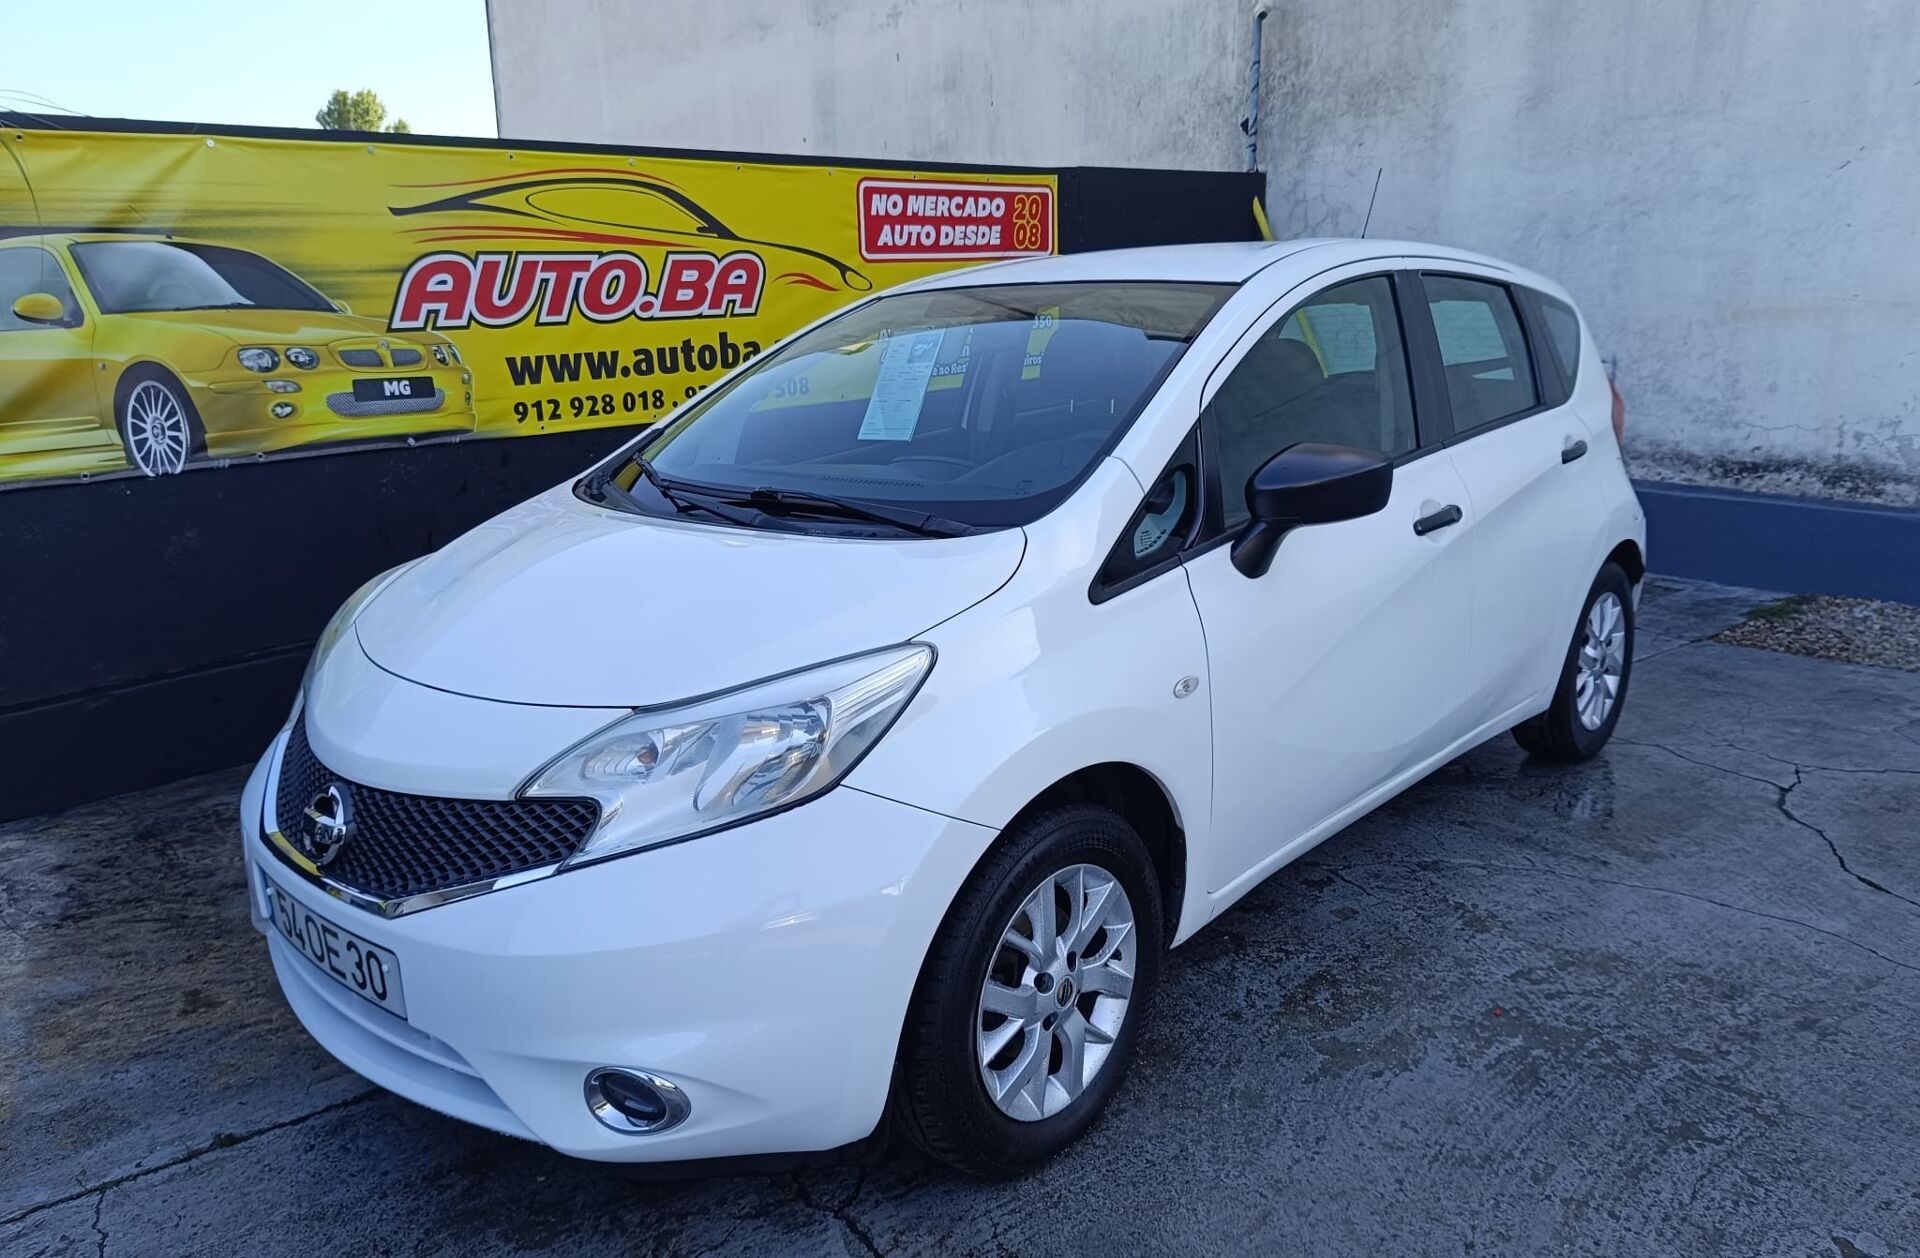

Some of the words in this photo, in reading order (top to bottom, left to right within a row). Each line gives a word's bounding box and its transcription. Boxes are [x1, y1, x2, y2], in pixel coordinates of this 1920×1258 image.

[870, 193, 903, 216] NO
[906, 195, 1006, 218] MERCADO
[1012, 194, 1042, 223] 20
[877, 224, 936, 247] AUTO
[939, 225, 1002, 247] DESDE
[1013, 221, 1042, 249] 08
[388, 252, 765, 332] AUTO.BA
[505, 332, 762, 387] www.autoba
[383, 380, 412, 396] MG
[513, 399, 562, 424] 912
[569, 394, 616, 418] 928
[623, 389, 665, 413] 018
